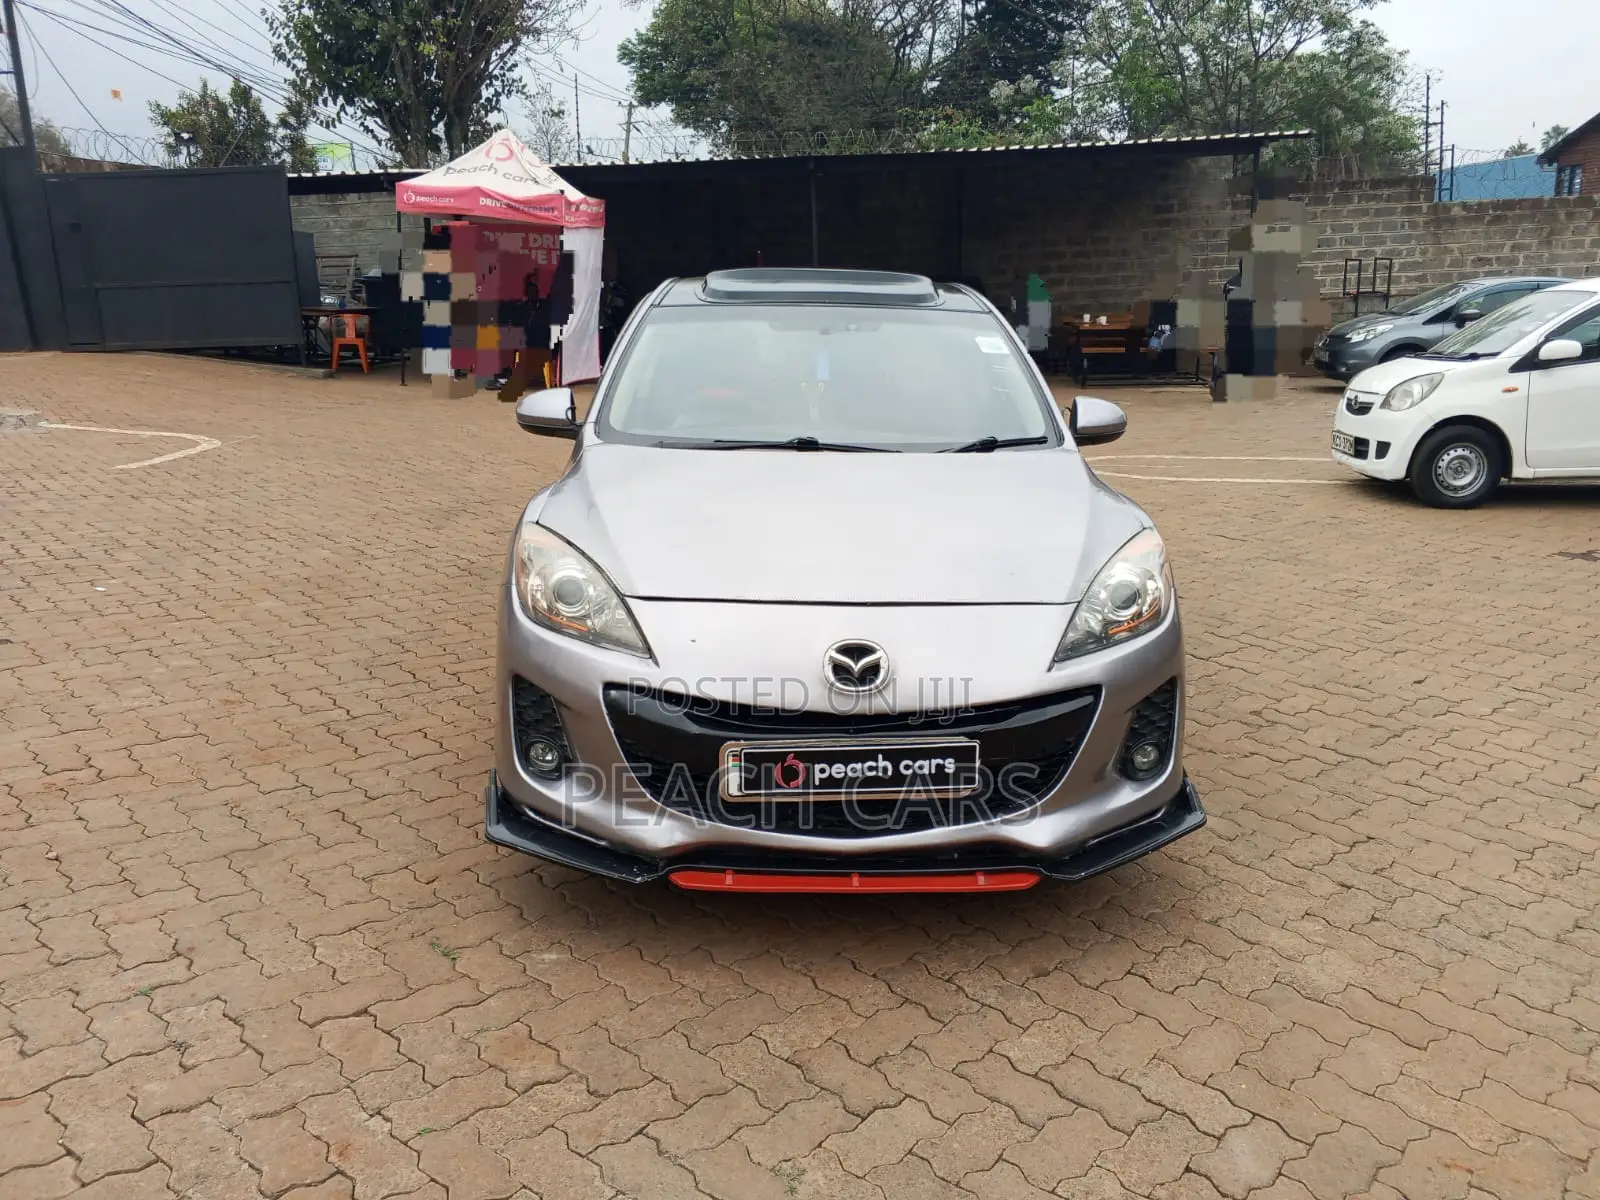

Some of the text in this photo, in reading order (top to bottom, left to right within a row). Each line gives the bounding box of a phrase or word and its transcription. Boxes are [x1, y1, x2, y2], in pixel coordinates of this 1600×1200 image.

[443, 163, 498, 177] peach
[814, 754, 956, 786] peach cars
